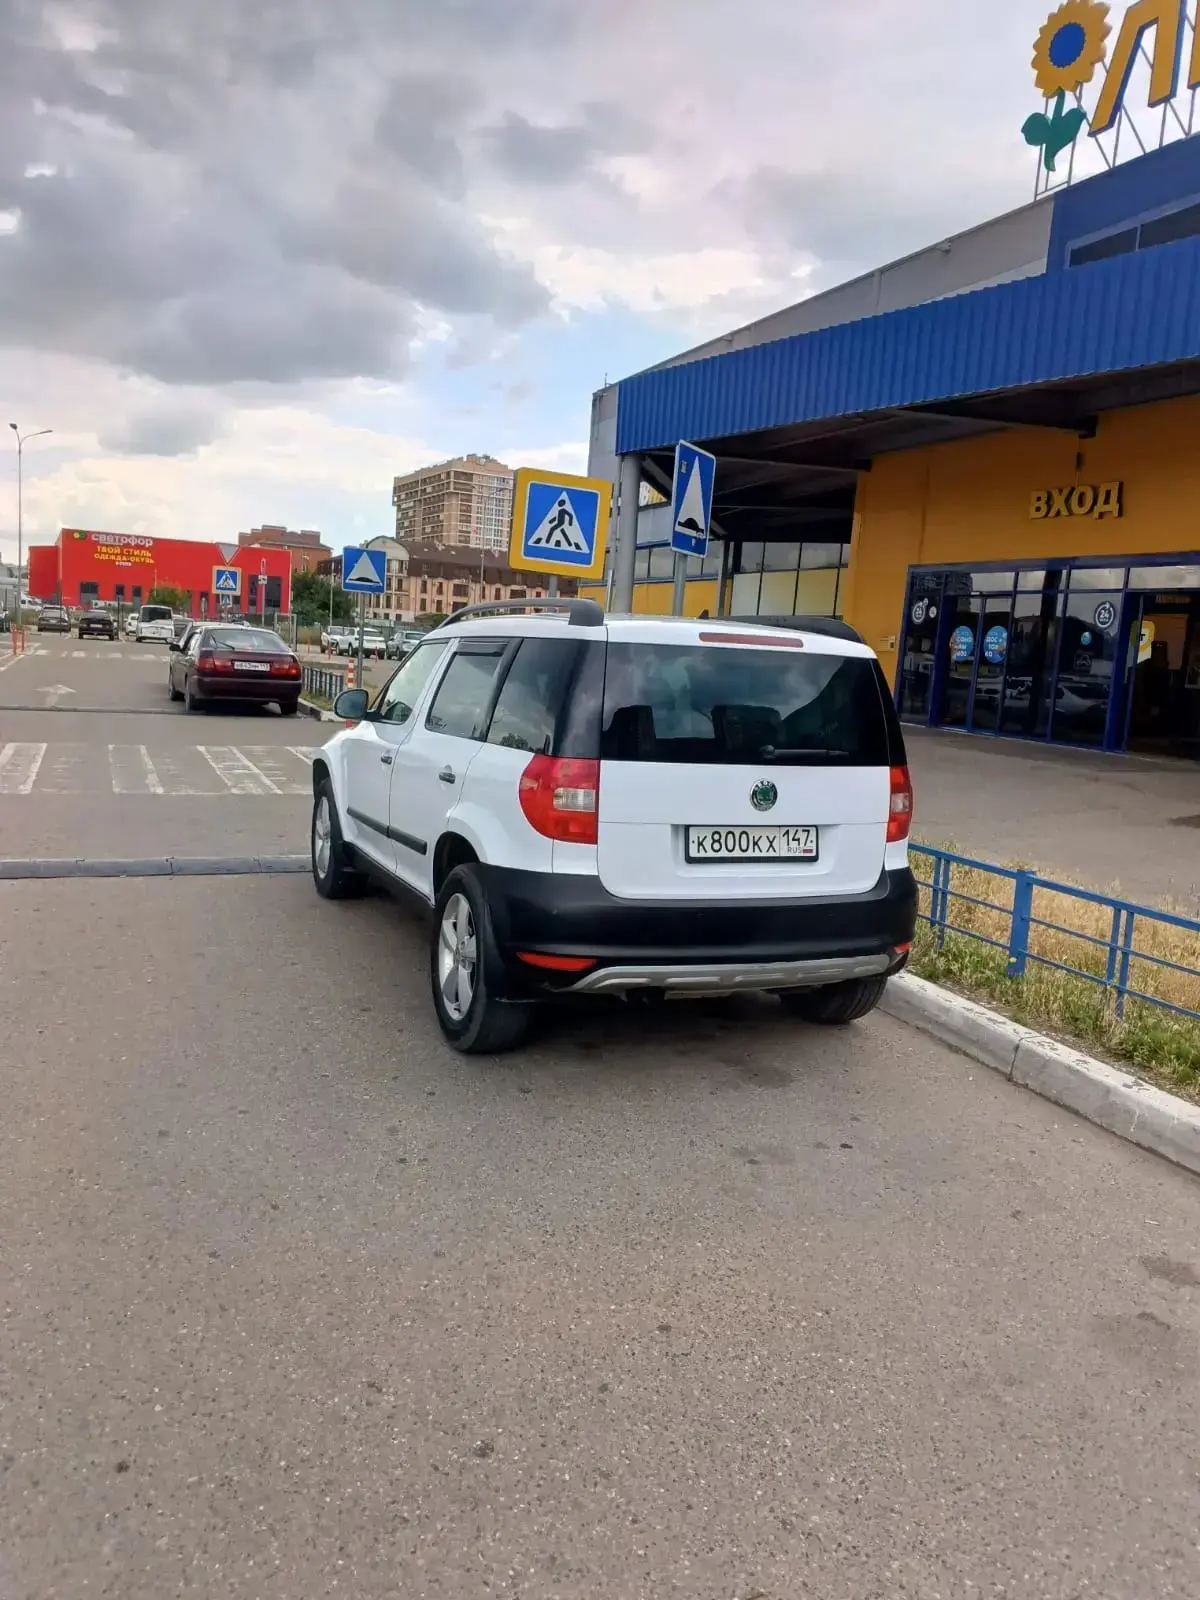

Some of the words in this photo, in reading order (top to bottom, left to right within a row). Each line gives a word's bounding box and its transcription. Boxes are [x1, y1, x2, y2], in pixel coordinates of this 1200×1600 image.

[1087, 0, 1200, 137] Л
[1030, 481, 1121, 519] ВХОД
[97, 545, 121, 554] ТВОЙ
[123, 548, 152, 557] СТИЛЬ
[1099, 609, 1110, 618] 24
[697, 830, 777, 854] К800КХ
[782, 829, 810, 847] 147
